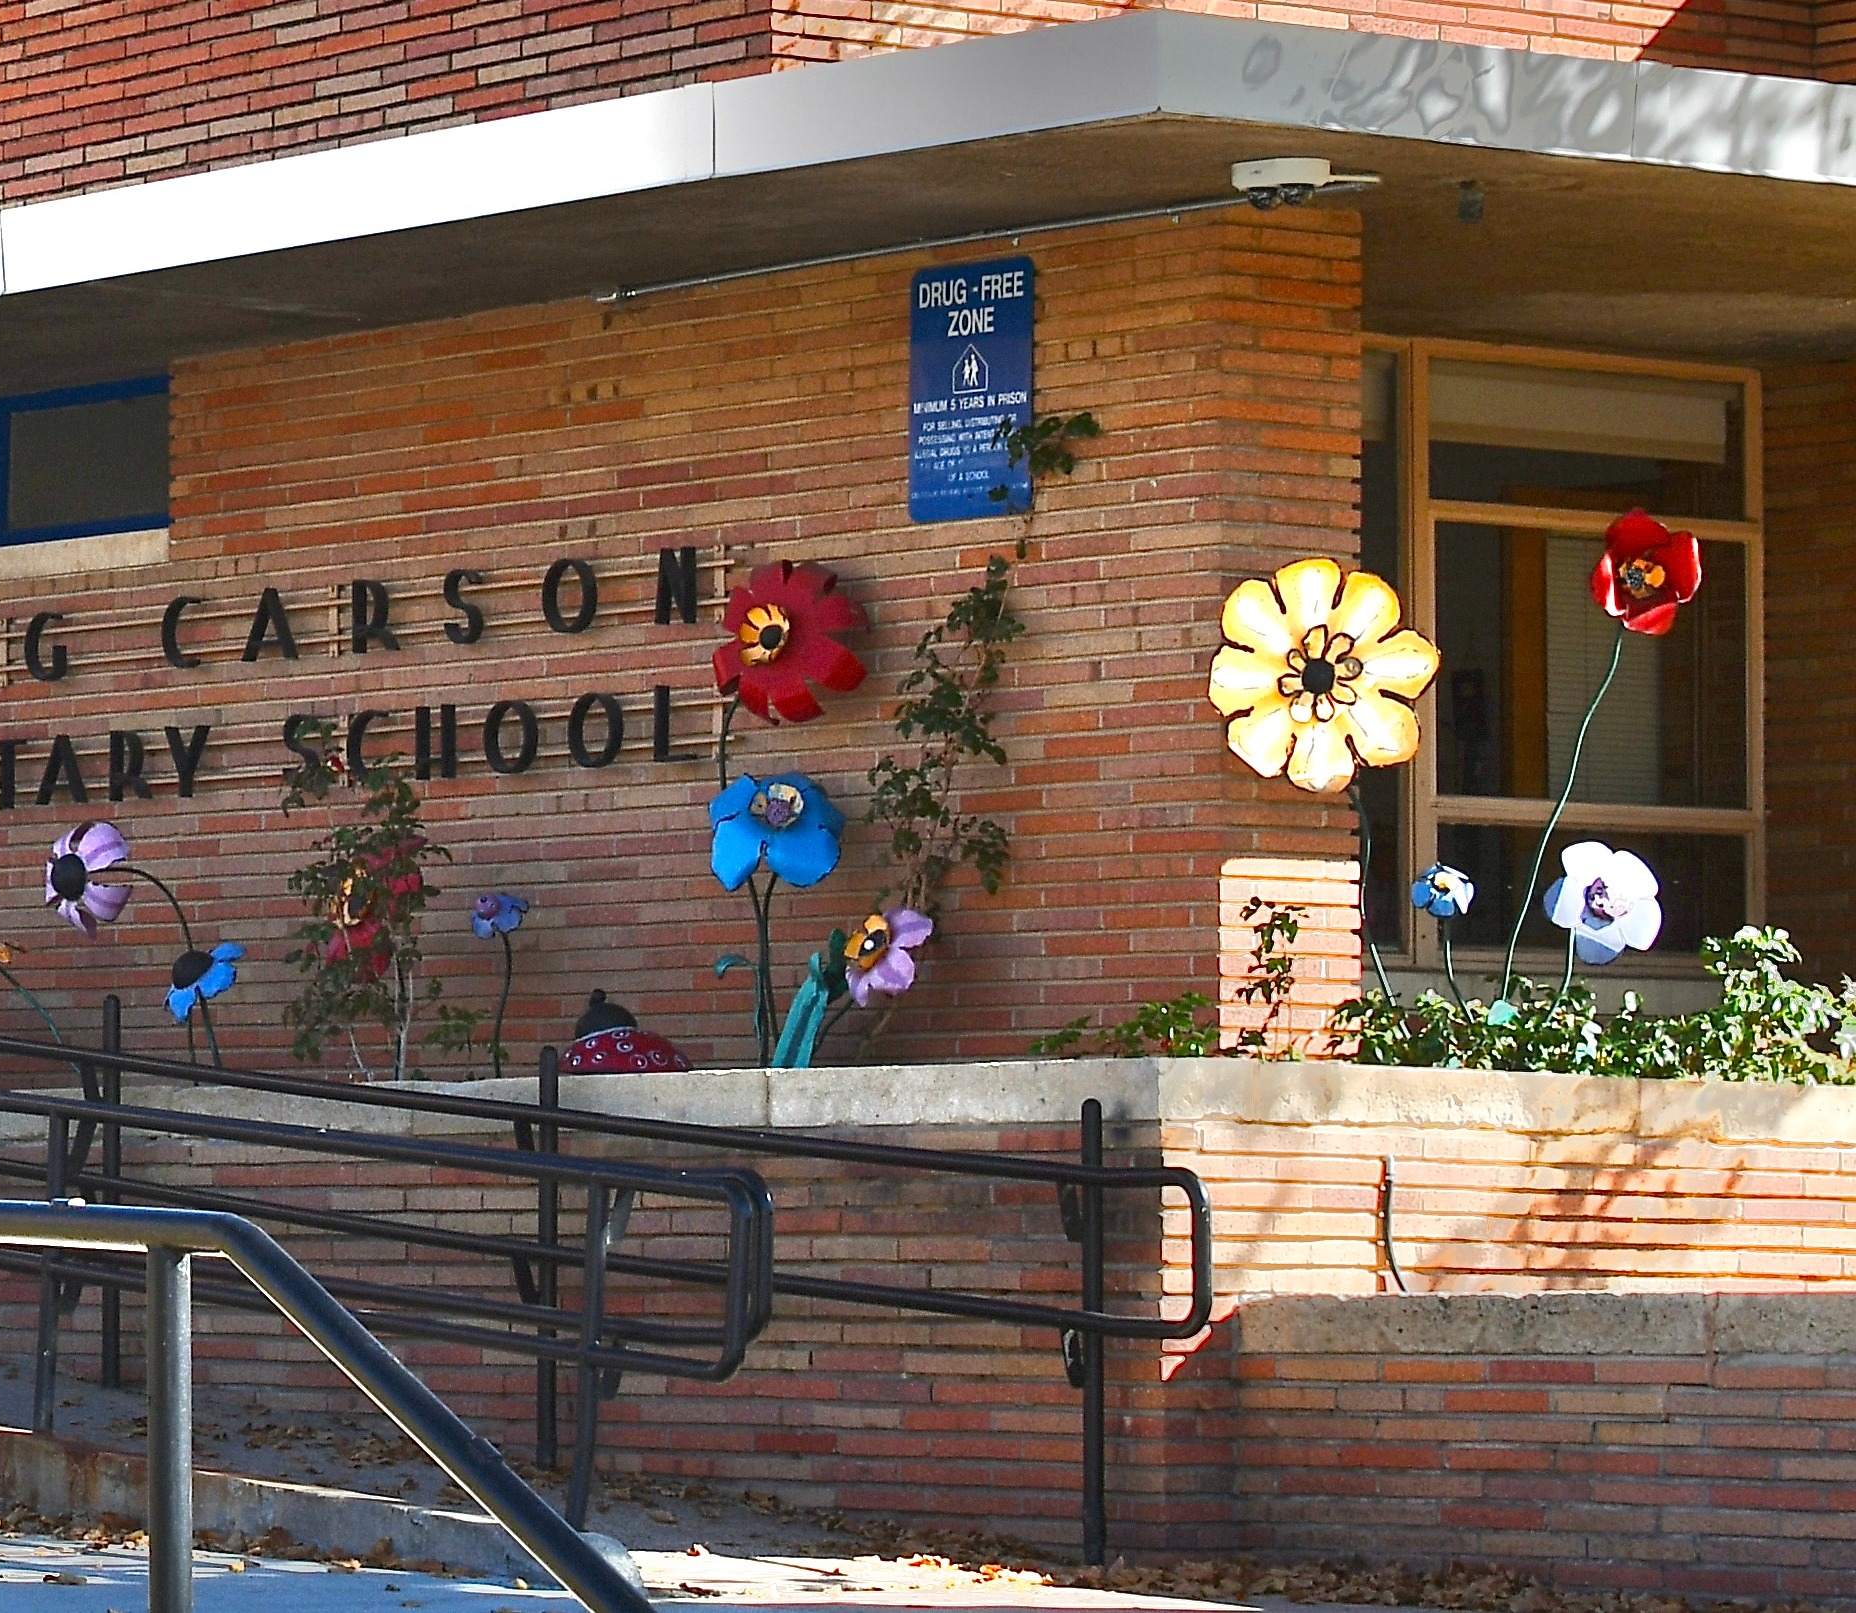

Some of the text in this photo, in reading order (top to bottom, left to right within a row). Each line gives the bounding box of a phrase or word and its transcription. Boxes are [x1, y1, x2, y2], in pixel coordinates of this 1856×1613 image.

[919, 278, 967, 309] DRUG
[947, 306, 995, 337] ZONE
[913, 391, 1027, 415] MINIMUM 5 YEARS IN PRISON
[24, 611, 67, 682] G
[161, 547, 698, 668] CARSON
[283, 685, 698, 786] SCHOOL
